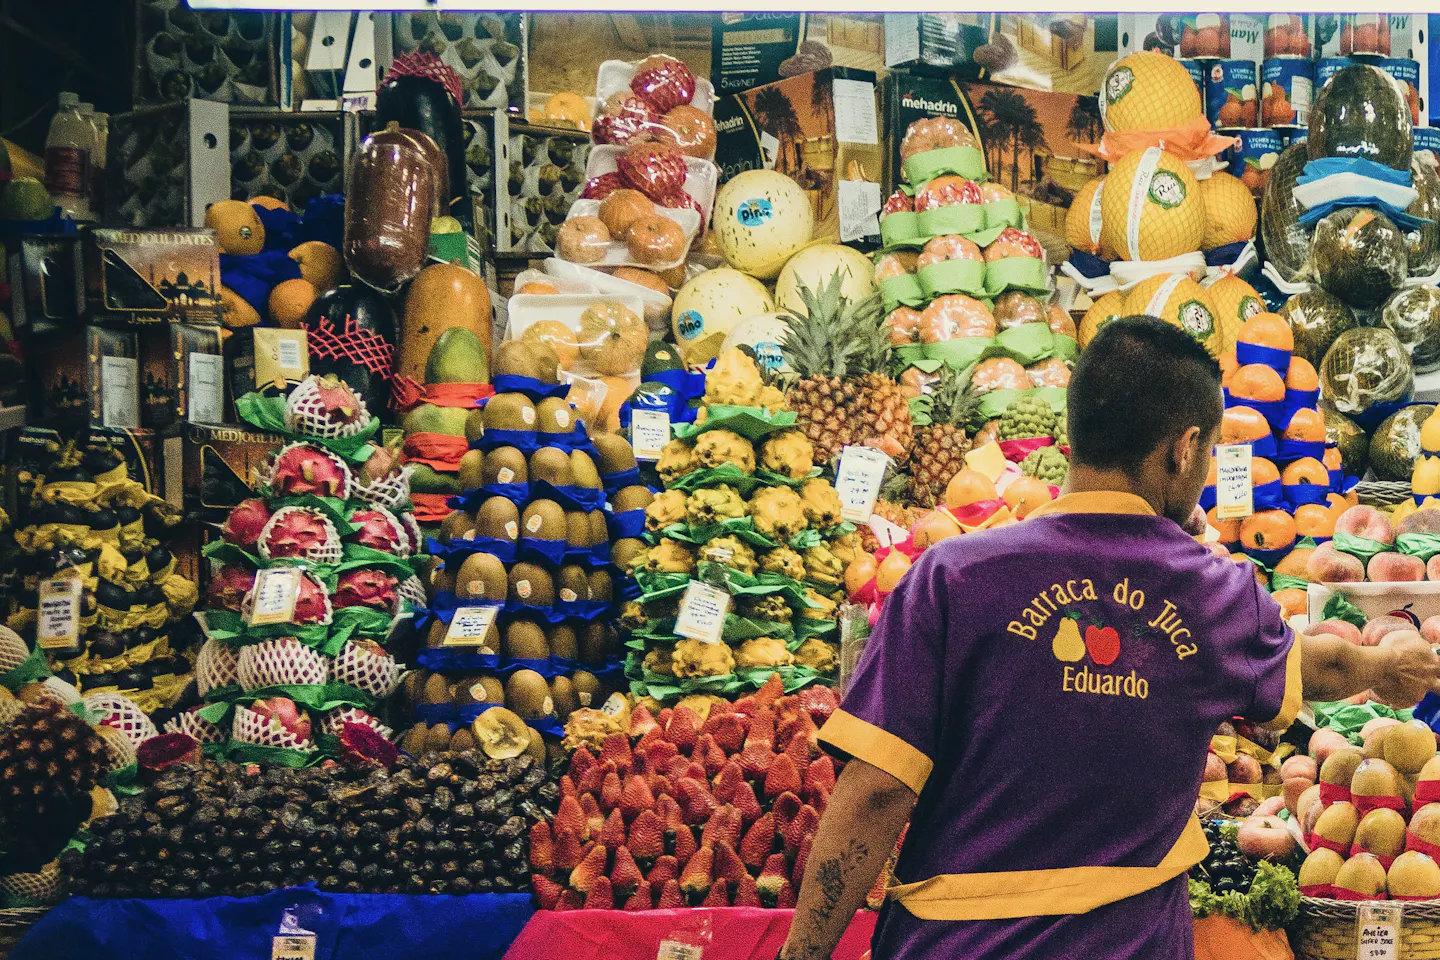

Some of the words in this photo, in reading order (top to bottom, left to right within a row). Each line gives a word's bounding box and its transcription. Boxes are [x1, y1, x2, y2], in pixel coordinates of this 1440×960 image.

[902, 97, 958, 114] mehadrin
[173, 232, 216, 246] DATES
[210, 429, 268, 445] MEDJOUL
[1007, 578, 1099, 641] Barraca
[1113, 577, 1146, 610] do
[1148, 599, 1199, 661] Juca
[1062, 665, 1149, 700] Eduardo
